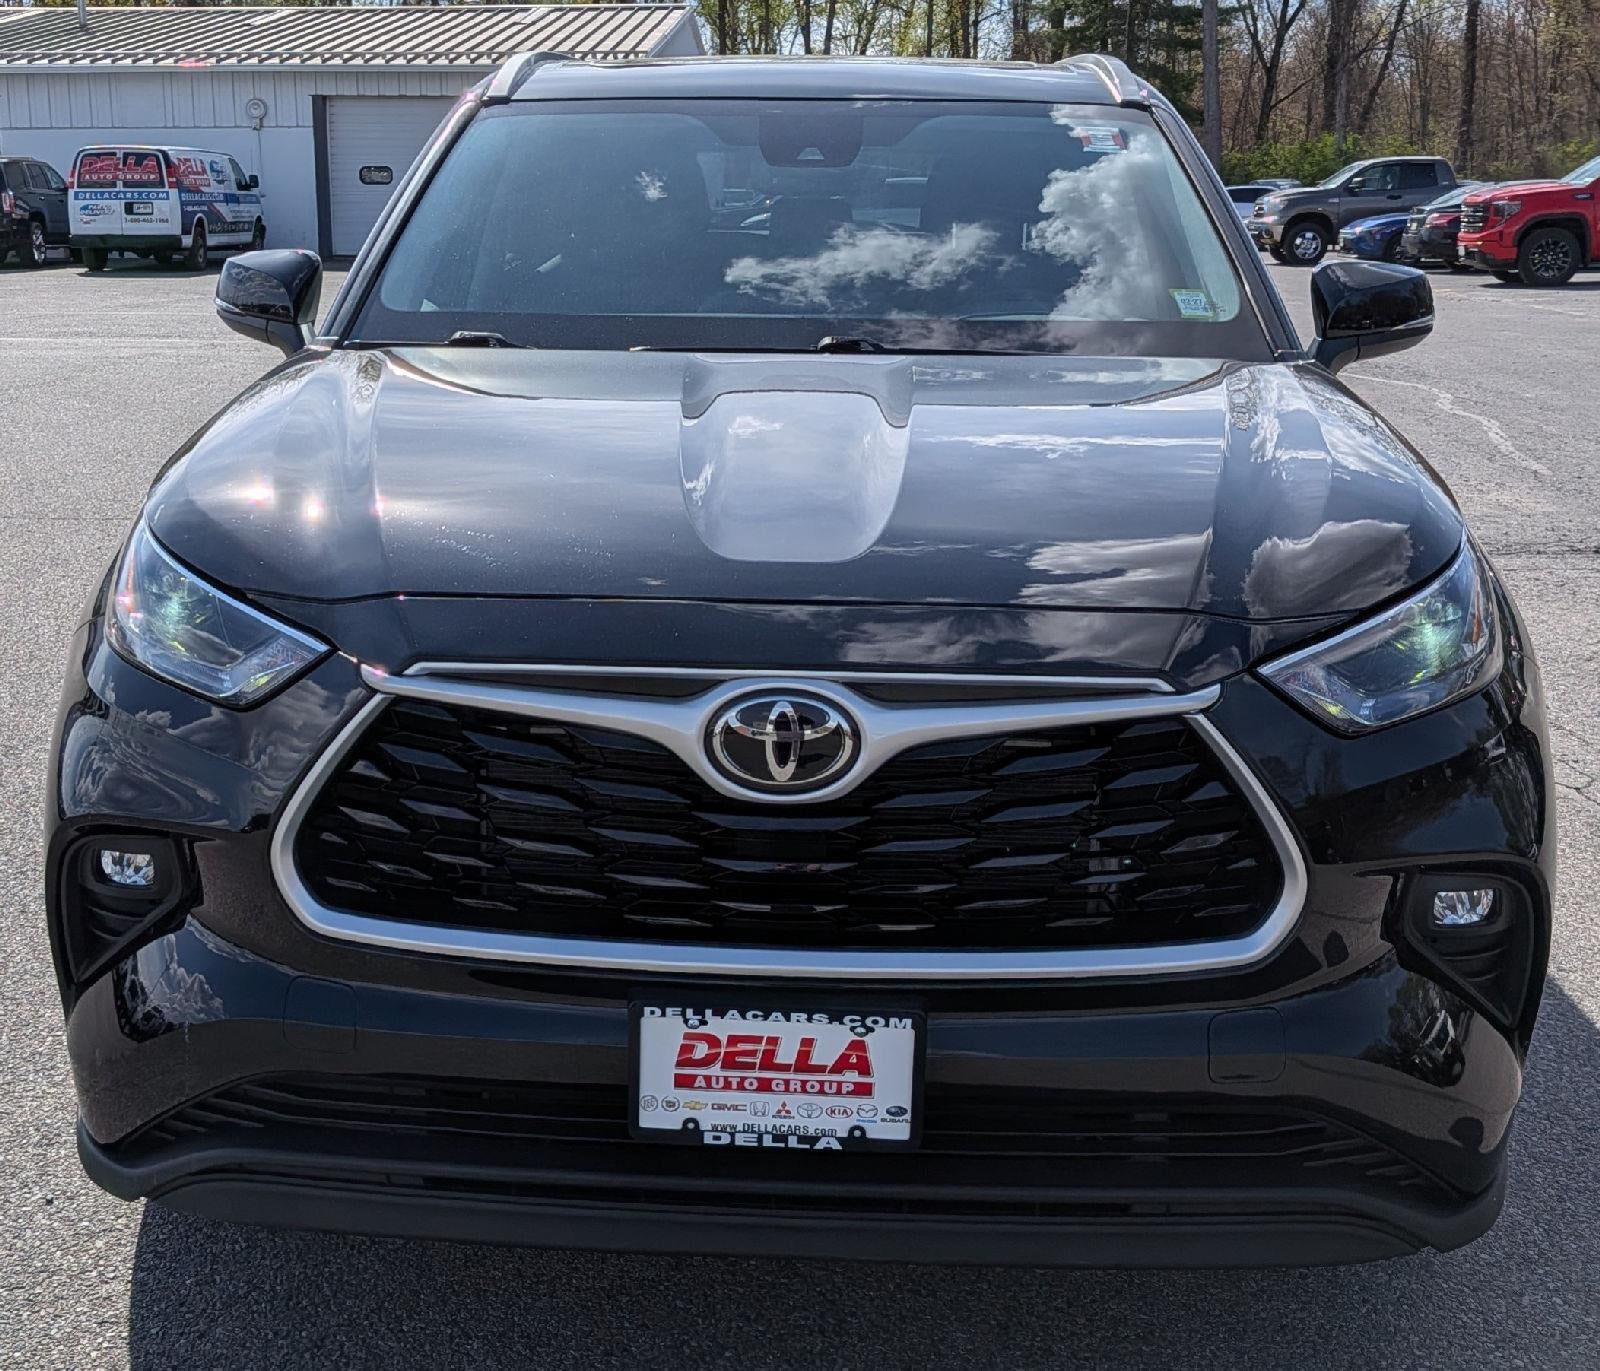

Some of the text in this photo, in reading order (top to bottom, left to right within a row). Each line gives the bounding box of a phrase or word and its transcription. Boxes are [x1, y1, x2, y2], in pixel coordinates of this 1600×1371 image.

[81, 155, 159, 173] DELLA
[176, 157, 209, 178] DELLA
[643, 1006, 913, 1029] DELLACARS.COM
[675, 1031, 875, 1078] DELLA
[693, 1076, 856, 1095] AUTO GROUP
[711, 1103, 748, 1112] GMC
[830, 1108, 849, 1117] KIA
[711, 1122, 837, 1137] www.DELLACARS.com
[703, 1131, 843, 1150] DELLA
